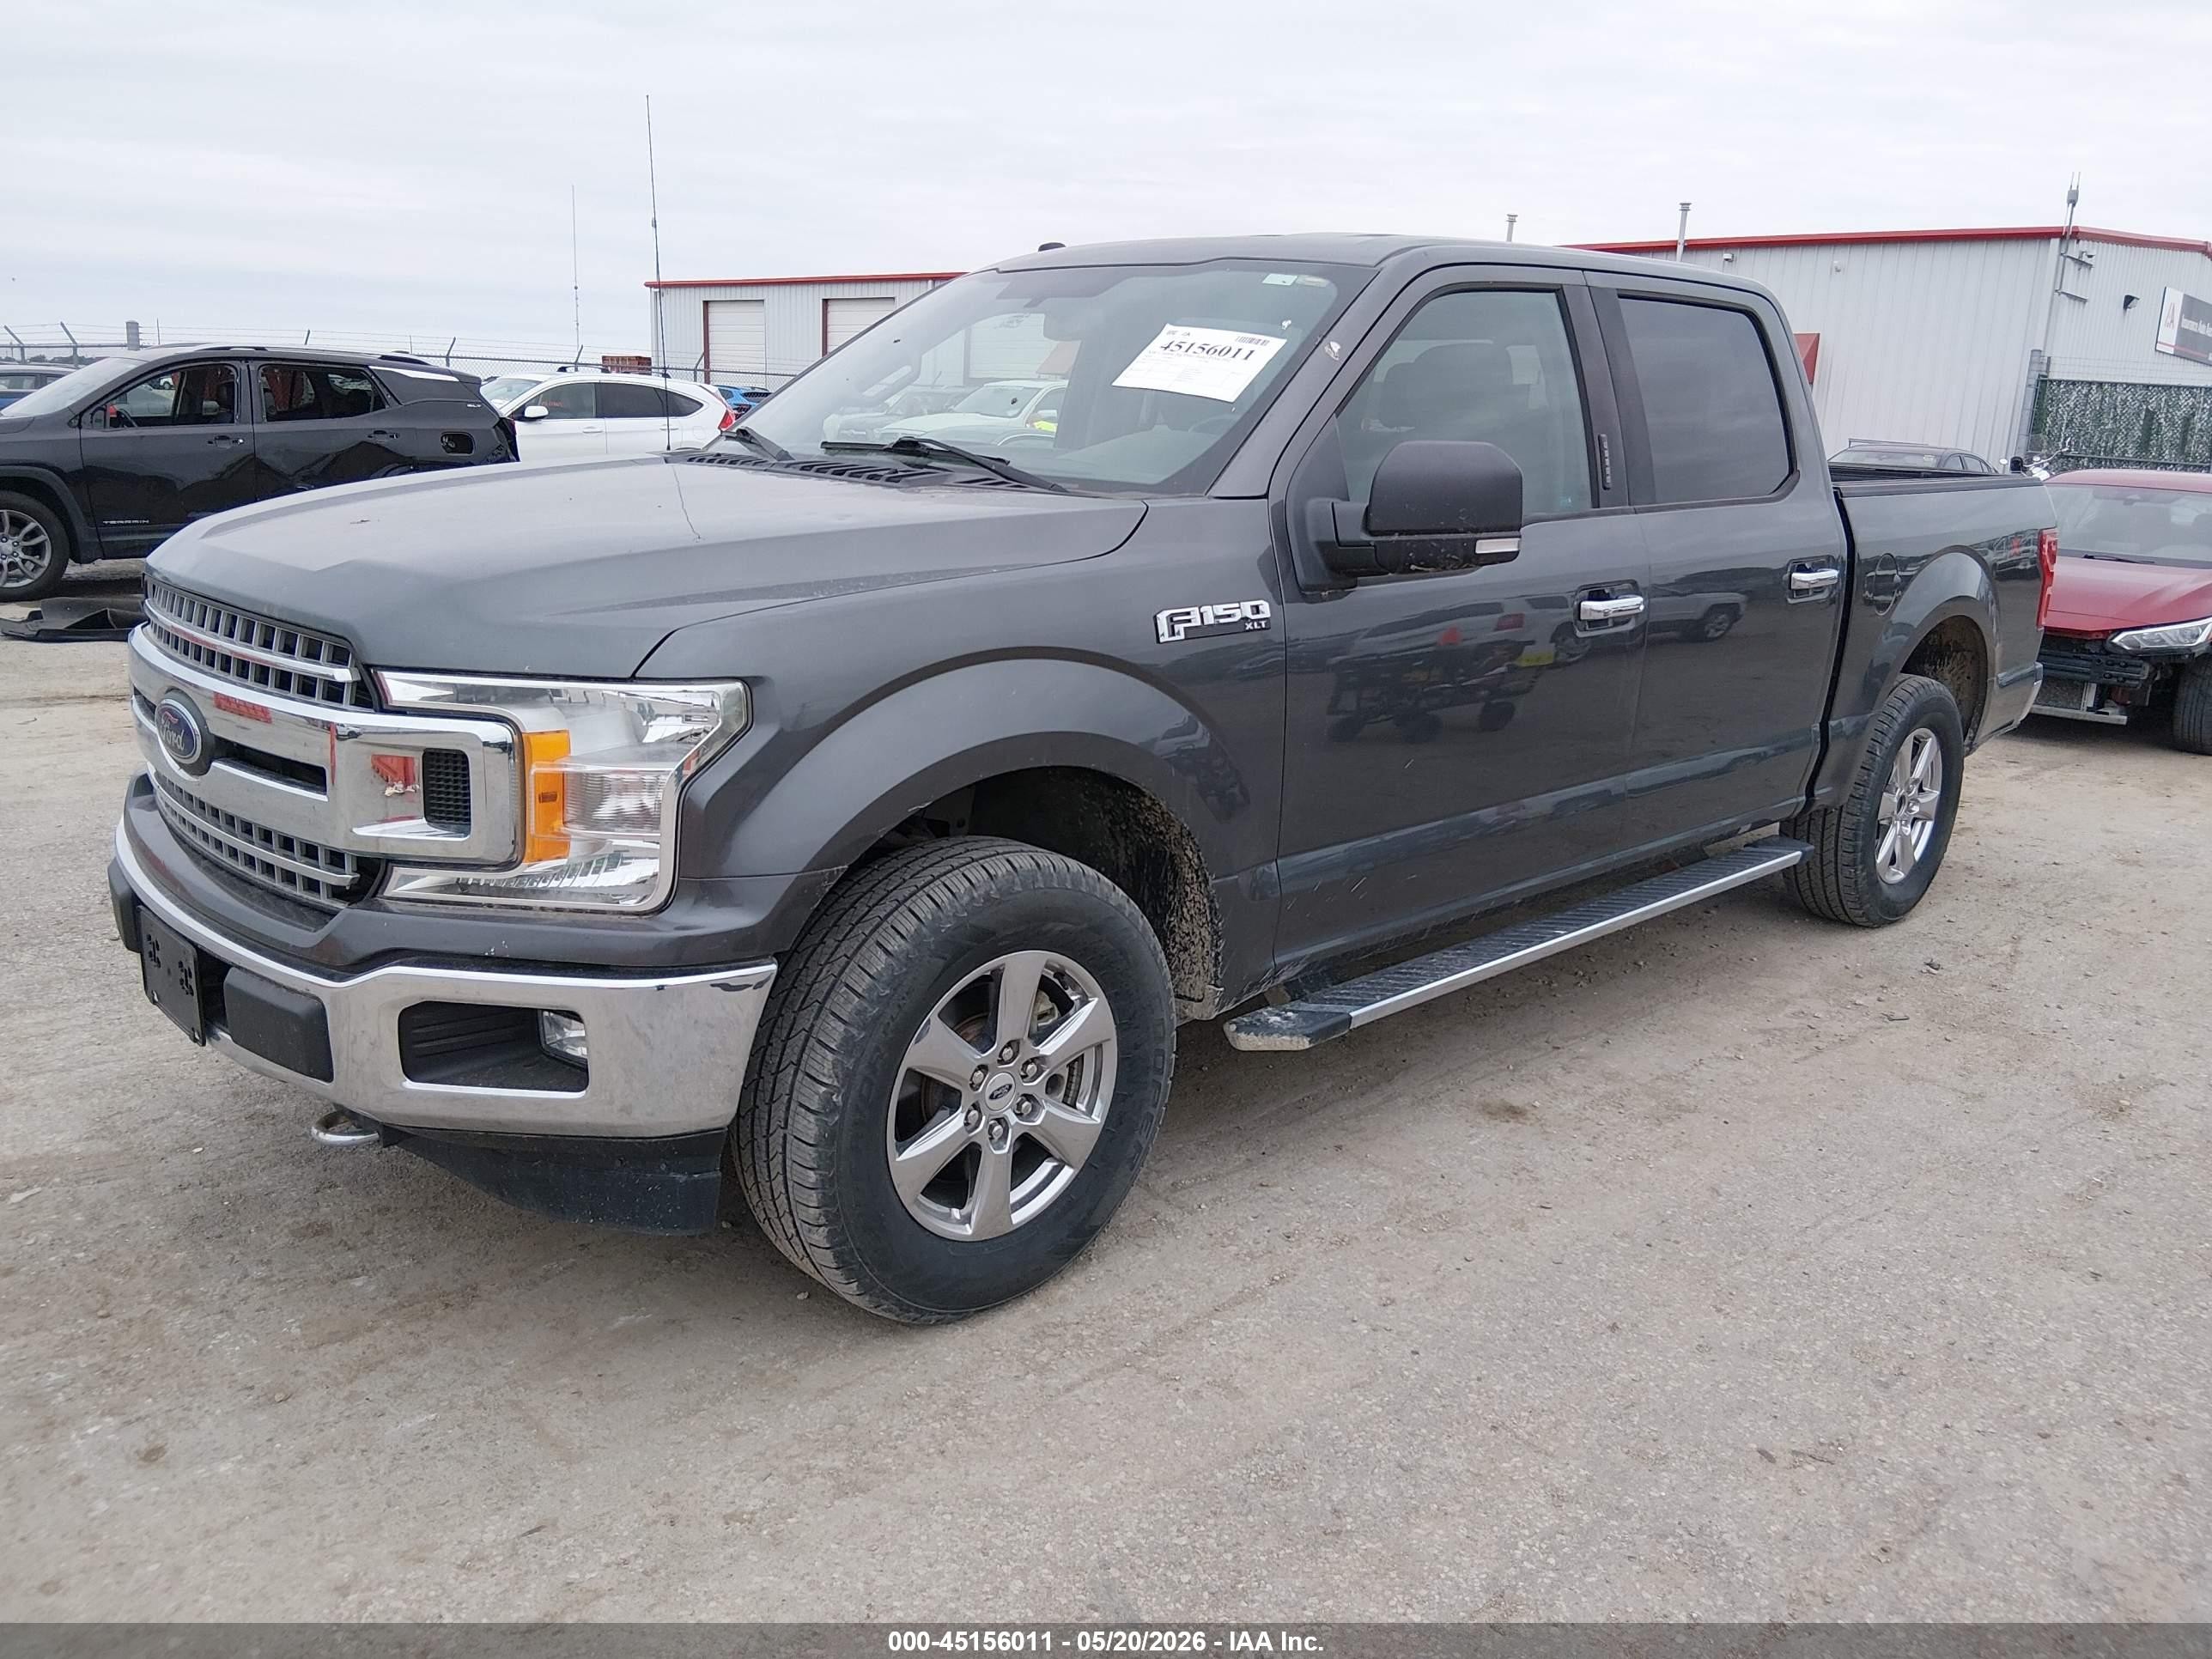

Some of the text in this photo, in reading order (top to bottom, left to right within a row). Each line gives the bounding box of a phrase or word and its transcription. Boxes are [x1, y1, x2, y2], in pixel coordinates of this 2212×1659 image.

[1160, 339, 1255, 361] 45156011
[1244, 620, 1267, 631] XLT
[160, 711, 185, 751] Ford
